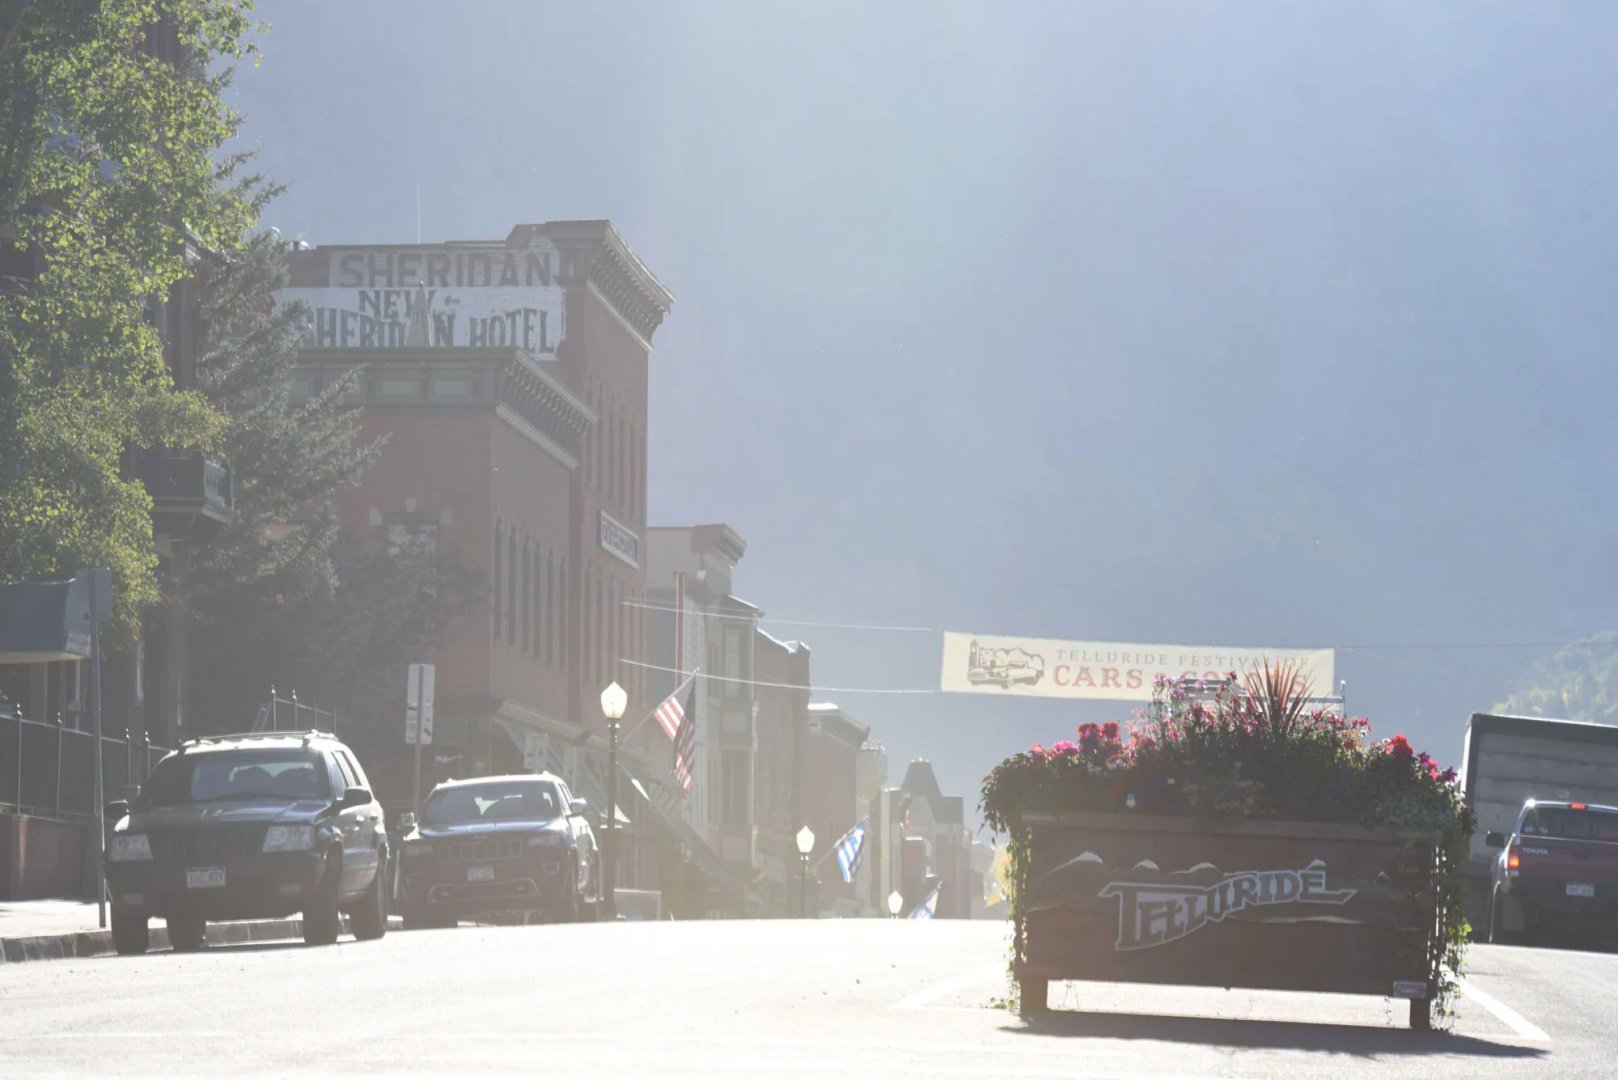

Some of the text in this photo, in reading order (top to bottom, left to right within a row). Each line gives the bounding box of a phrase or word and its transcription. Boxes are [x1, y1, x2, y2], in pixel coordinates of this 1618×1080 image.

[340, 251, 550, 288] SHERIDAN
[296, 308, 554, 354] HERIDN HOTEL
[1055, 648, 1168, 667] TELLURIDE
[1284, 656, 1310, 671] OF
[1052, 664, 1144, 690] CARS
[1522, 847, 1549, 856] TOYOTA
[1098, 868, 1358, 951] TELLURIDE
